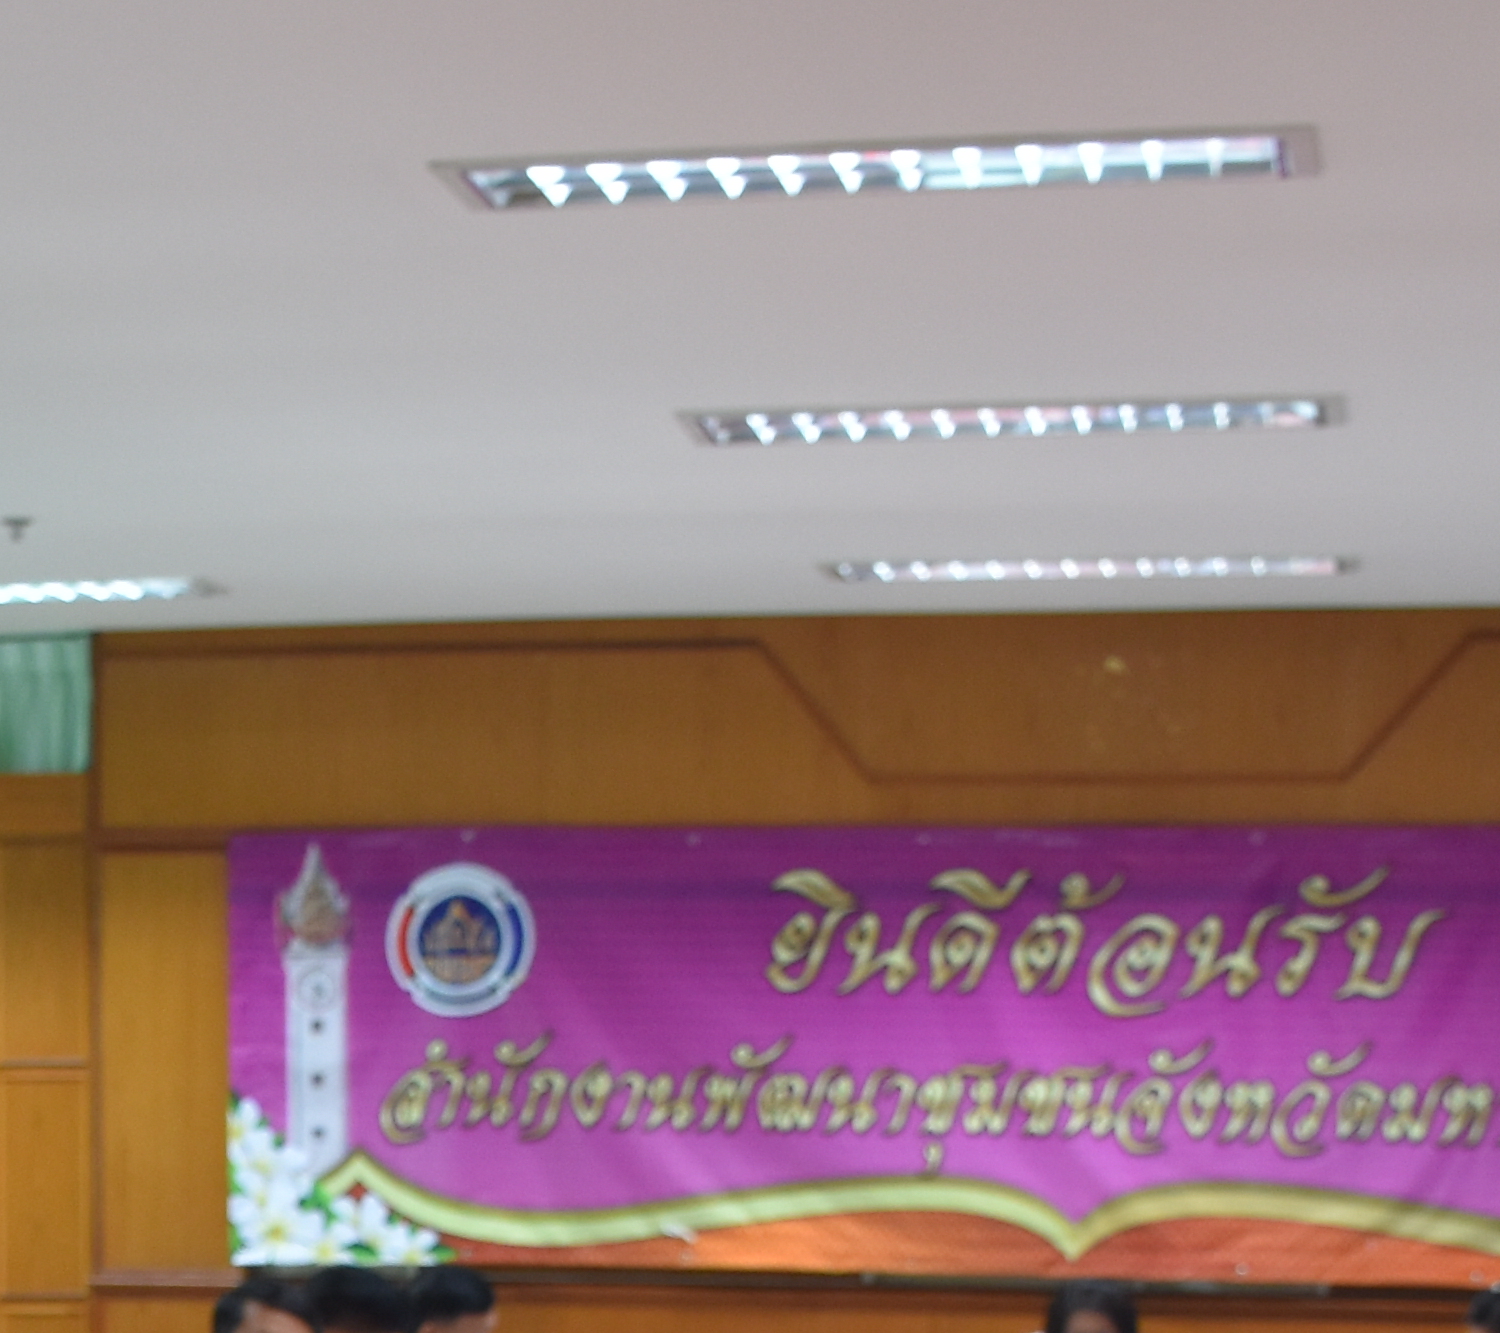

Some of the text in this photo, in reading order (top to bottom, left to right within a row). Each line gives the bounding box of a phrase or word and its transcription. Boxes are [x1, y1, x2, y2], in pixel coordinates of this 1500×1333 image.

[765, 865, 1447, 1018] ยินดีต้อนรับ
